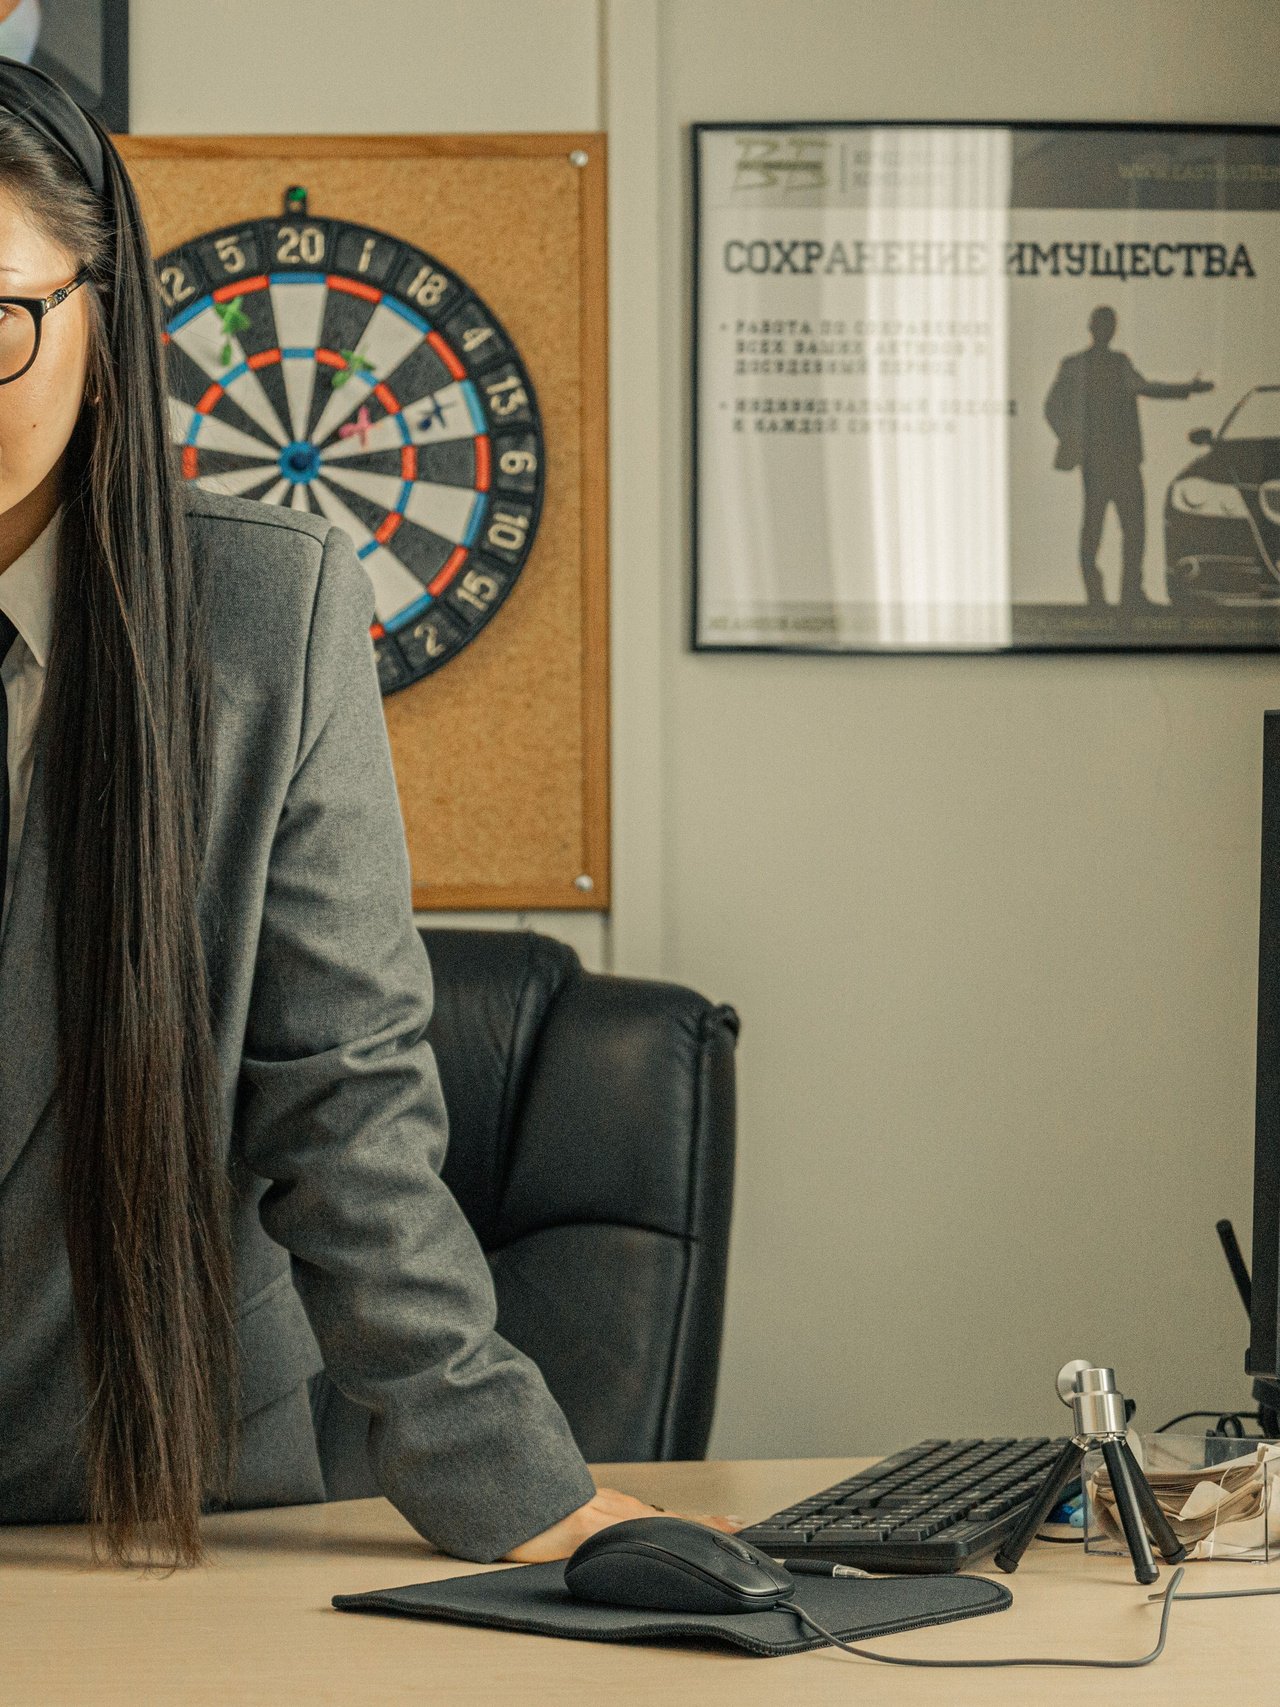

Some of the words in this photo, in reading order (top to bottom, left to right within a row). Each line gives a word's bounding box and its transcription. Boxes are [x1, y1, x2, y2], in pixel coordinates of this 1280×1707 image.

[214, 235, 246, 274] 5
[276, 227, 325, 264] 20
[723, 239, 989, 275] СОХРАНЕНИЕ
[1002, 240, 1257, 282] ИМУЩЕСТВА
[407, 265, 448, 307] 18
[462, 327, 494, 352] 4
[486, 375, 528, 415] 13
[499, 450, 538, 475] 6
[487, 511, 530, 551] 10
[456, 570, 499, 612] 15
[414, 624, 447, 657] 2
